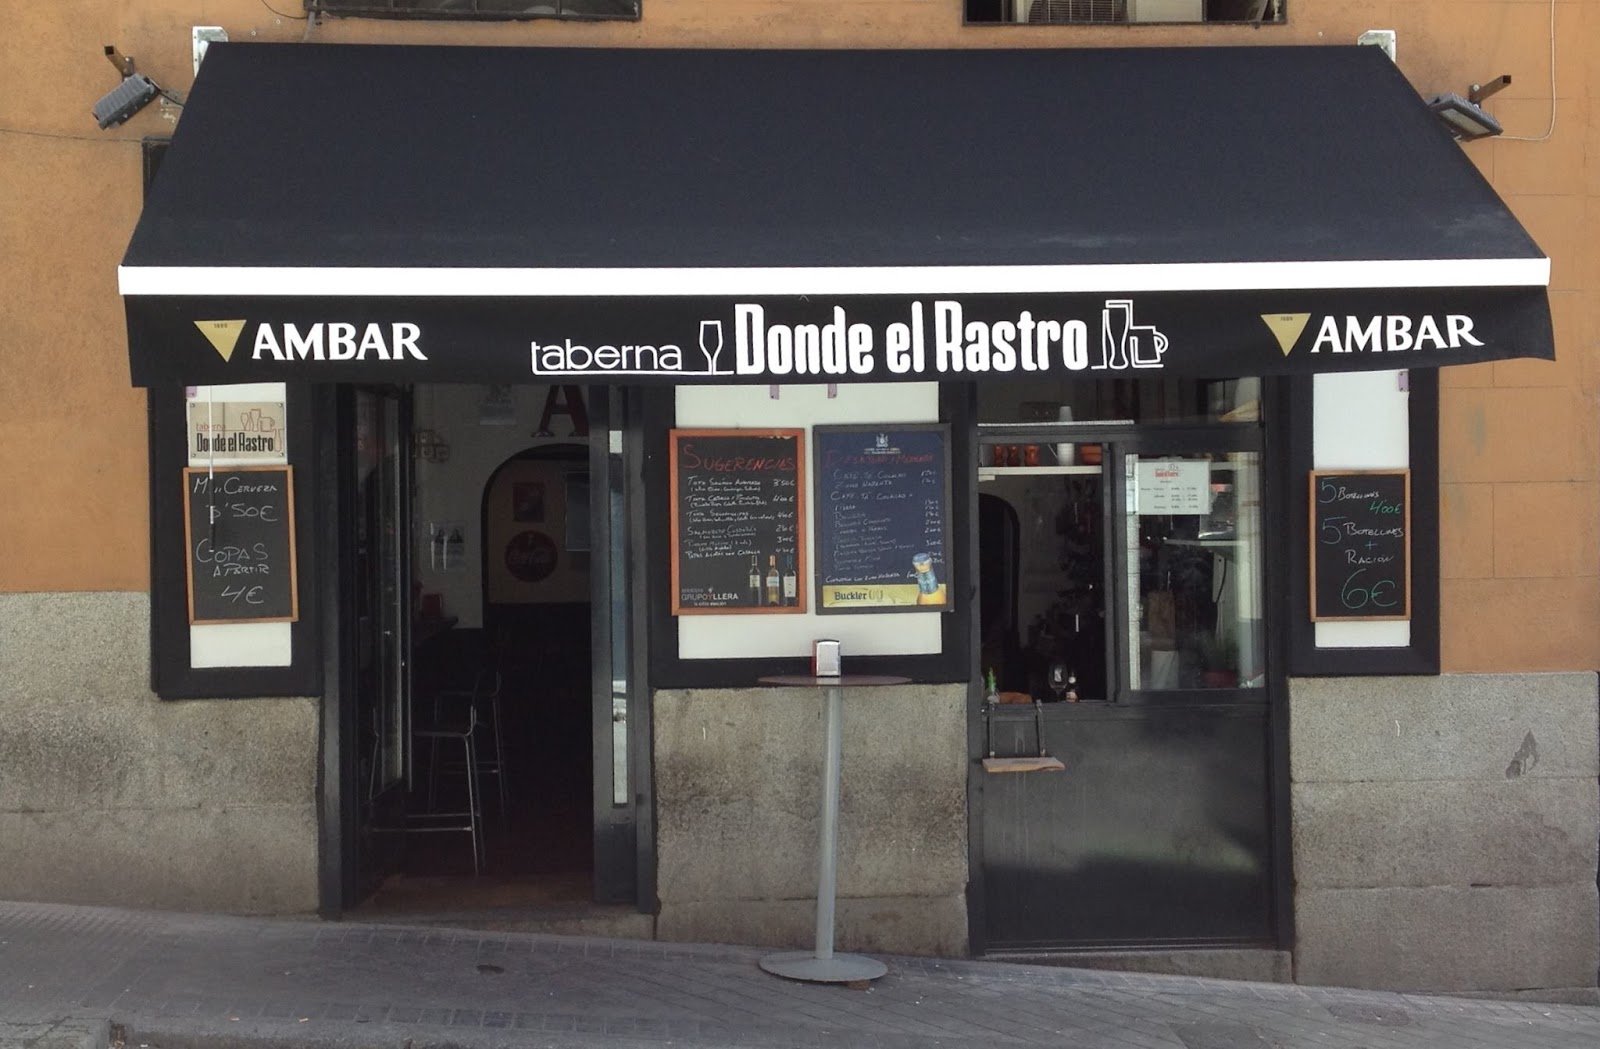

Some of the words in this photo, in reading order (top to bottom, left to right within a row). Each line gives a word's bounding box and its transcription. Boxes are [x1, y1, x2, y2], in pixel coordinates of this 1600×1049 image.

[252, 322, 429, 361] AMBAR
[531, 338, 682, 371] taberna
[734, 303, 874, 375] Donde
[886, 301, 925, 373] el
[935, 301, 1089, 372] Rastro
[1311, 315, 1486, 353] AMBAR
[196, 423, 226, 431] tabrna
[228, 432, 237, 452] el
[239, 432, 274, 452] Rastro
[834, 591, 868, 601] Buckler
